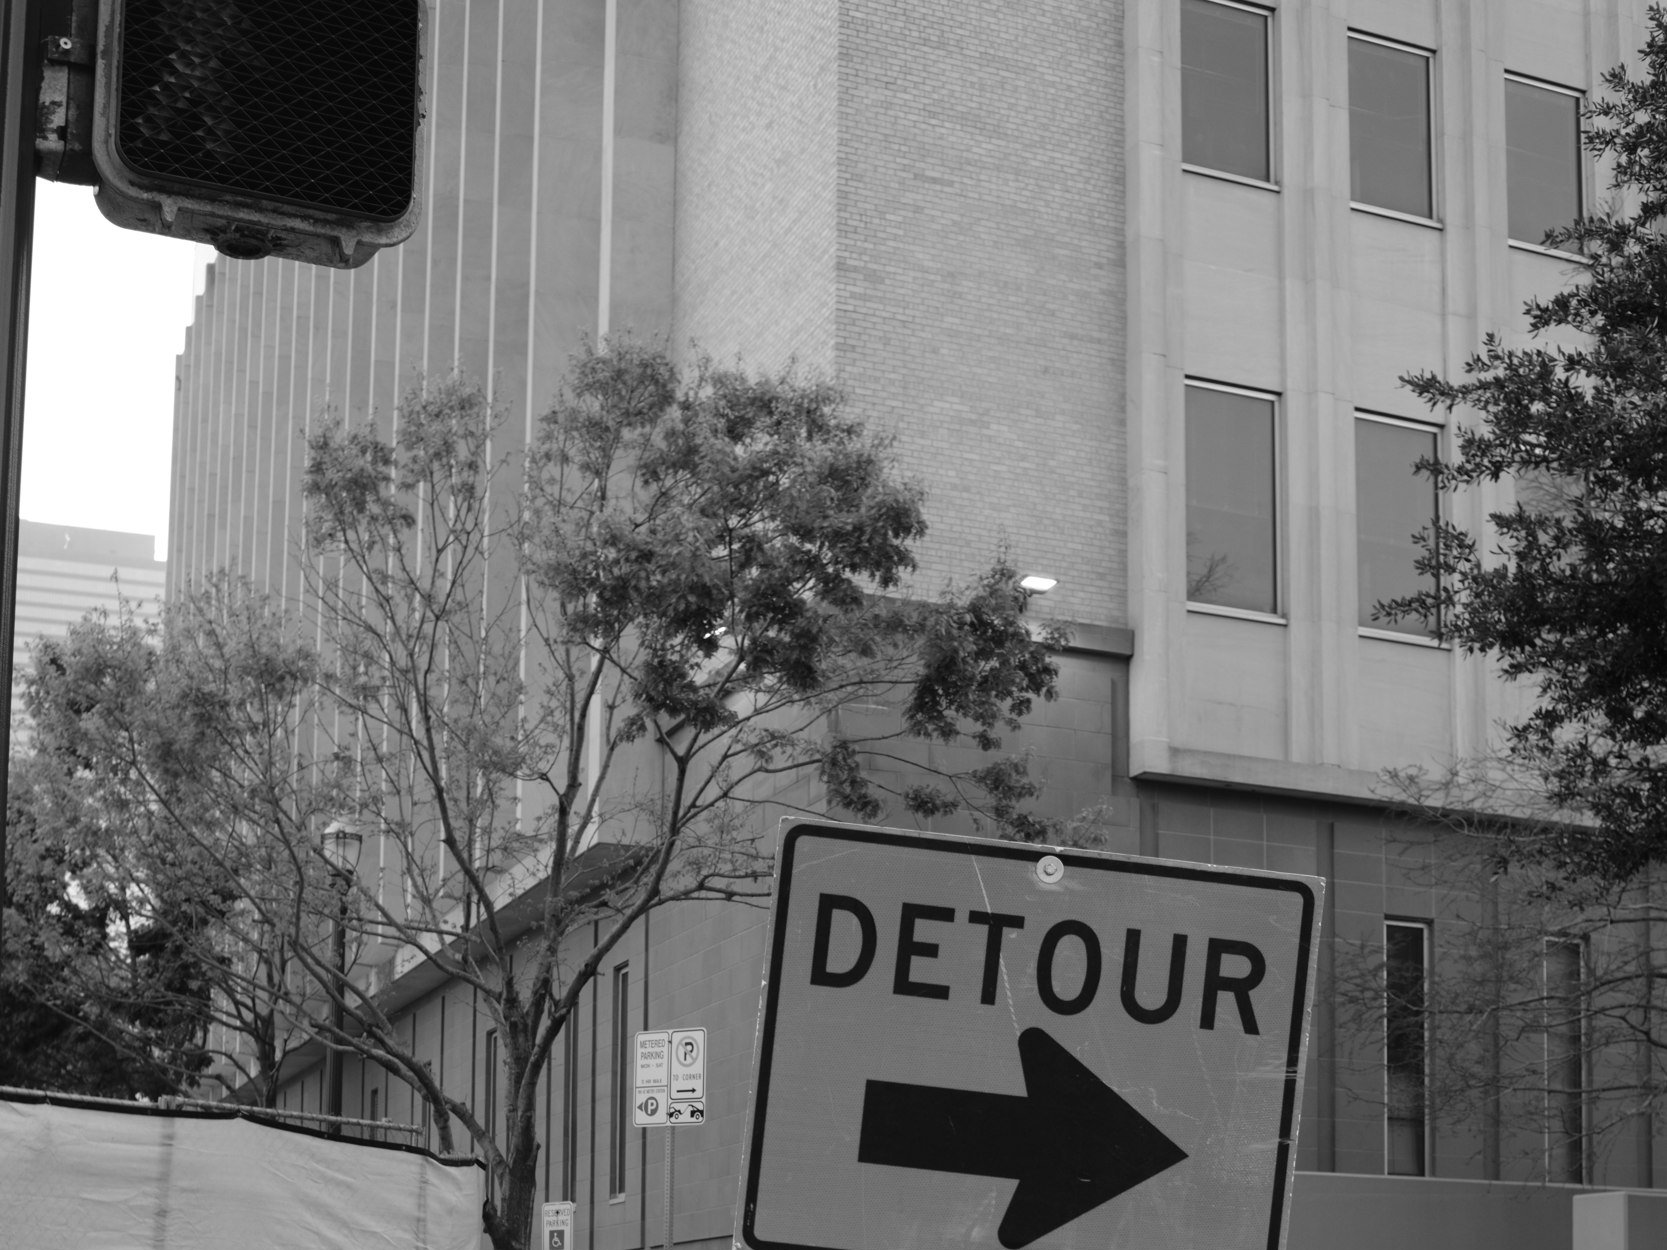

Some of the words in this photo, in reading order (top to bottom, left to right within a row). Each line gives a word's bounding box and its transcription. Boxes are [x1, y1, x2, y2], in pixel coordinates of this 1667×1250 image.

[809, 892, 1267, 1036] DETOUR
[640, 1039, 665, 1049] METERED
[640, 1050, 664, 1060] PARKING
[683, 1073, 701, 1081] CORNER
